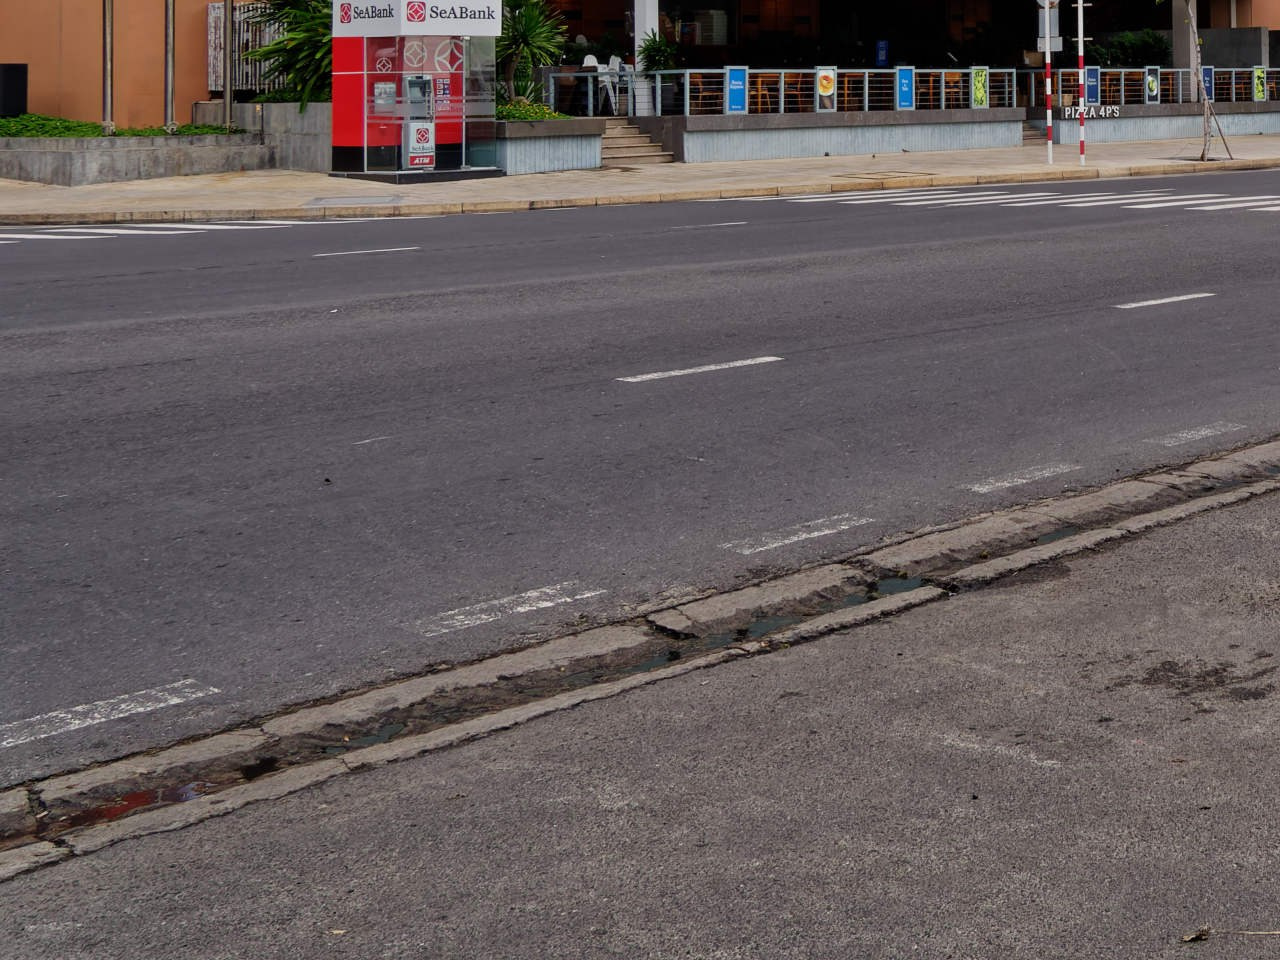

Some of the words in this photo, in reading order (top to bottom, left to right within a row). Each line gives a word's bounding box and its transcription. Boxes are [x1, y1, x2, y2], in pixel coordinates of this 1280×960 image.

[353, 4, 394, 20] SeABank
[429, 5, 496, 20] SeABank
[1065, 106, 1097, 119] PIZZA
[1099, 105, 1120, 118] 4P'S
